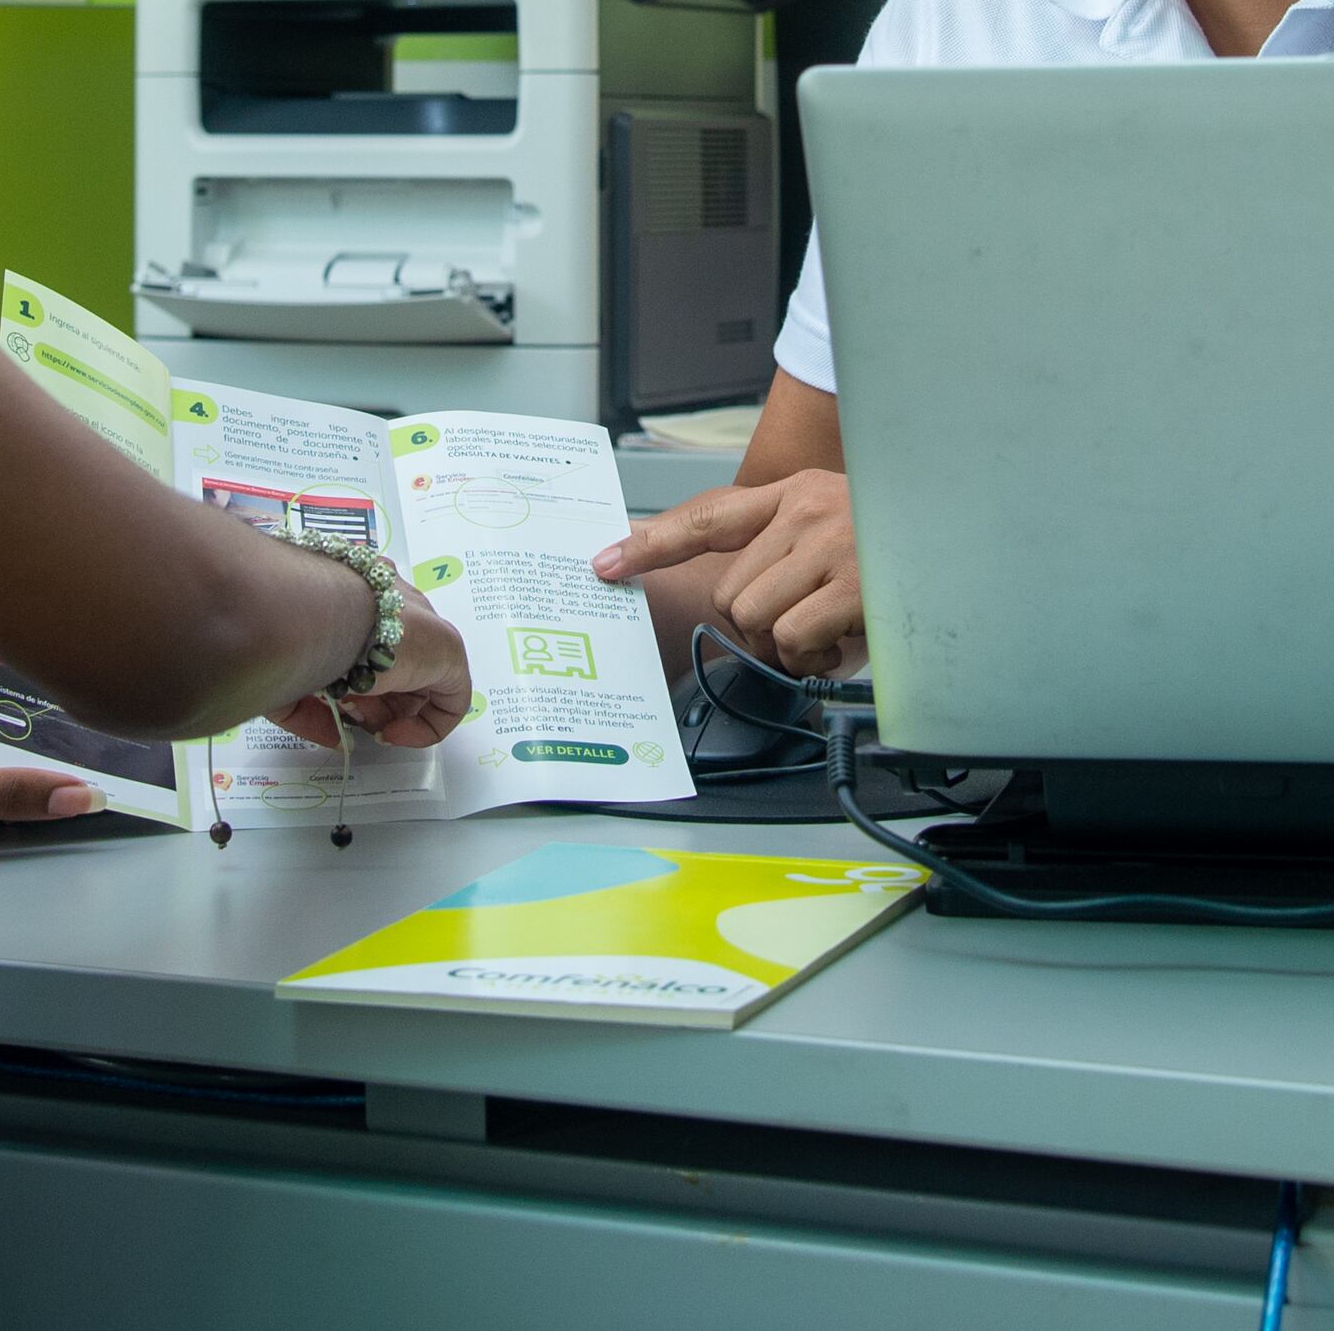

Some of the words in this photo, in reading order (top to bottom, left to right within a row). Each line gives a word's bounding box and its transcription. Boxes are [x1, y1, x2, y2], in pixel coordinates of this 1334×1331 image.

[49, 312, 81, 334] Ingresa
[82, 331, 89, 341] al
[90, 336, 125, 364] siguiente
[190, 401, 209, 418] 4.
[222, 405, 253, 418] Debes
[271, 415, 310, 428] ingresar
[329, 424, 348, 433] tipo
[366, 431, 377, 439] de
[91, 420, 100, 430] el
[125, 439, 134, 450] en
[136, 443, 144, 455] la
[222, 415, 281, 433] documento,
[287, 428, 363, 444] posteriormente
[368, 440, 379, 448] tu
[223, 426, 262, 439] número
[276, 435, 288, 444] de
[303, 438, 361, 452] documento
[411, 431, 433, 445] 6.
[457, 428, 507, 437] desplegar
[508, 431, 526, 439] mis
[529, 432, 599, 447] oportunidades
[223, 434, 276, 451] finalmente
[278, 445, 289, 453] tu
[291, 448, 349, 460] contraseña.
[445, 436, 491, 444] laborales
[494, 438, 530, 448] puedes
[532, 441, 587, 454] seleccionar
[225, 451, 282, 467] (Generalmente
[284, 461, 293, 469] tu
[294, 463, 338, 474] contraseña
[514, 454, 560, 464] VACANTES.
[236, 460, 244, 468] el
[245, 463, 272, 473] mismo
[273, 468, 304, 478] número
[306, 471, 317, 479] de
[432, 564, 451, 581] 7.
[482, 567, 509, 577] perfil
[528, 568, 537, 576] el
[565, 574, 582, 583] por
[486, 559, 532, 567] vacantes
[538, 561, 594, 575] disponibles
[470, 578, 552, 586] recomendamos
[560, 581, 616, 593] seleccionar
[624, 587, 634, 596] la
[471, 585, 506, 593] ciudad
[509, 585, 542, 594] donde
[544, 588, 580, 598] resides
[590, 592, 623, 603] donde
[626, 596, 635, 604] te
[472, 594, 515, 603] interesa
[518, 595, 557, 604] laborar.
[562, 598, 580, 607] Las
[583, 601, 628, 613] ciudades
[632, 607, 638, 615] y
[474, 602, 532, 612] municipios
[537, 604, 553, 613] los
[559, 607, 621, 619] encontrarás
[626, 614, 640, 622] en
[476, 612, 508, 621] orden
[26, 695, 35, 704] de
[489, 686, 527, 696] Podrás
[530, 687, 578, 697] visualizar
[580, 690, 595, 698] las
[598, 693, 645, 703] vacantes
[490, 699, 505, 707] en
[521, 695, 557, 704] ciudad
[560, 697, 574, 705] de
[576, 699, 612, 708] interés
[494, 717, 508, 725] de
[566, 716, 581, 725] de
[598, 719, 634, 729] interés
[552, 706, 591, 716] ampliar
[594, 709, 658, 721] información
[496, 725, 533, 735] dando
[535, 724, 554, 732] clic
[526, 745, 554, 755] VER
[556, 747, 616, 759] DETALLE
[447, 967, 727, 994] Comfenalco
